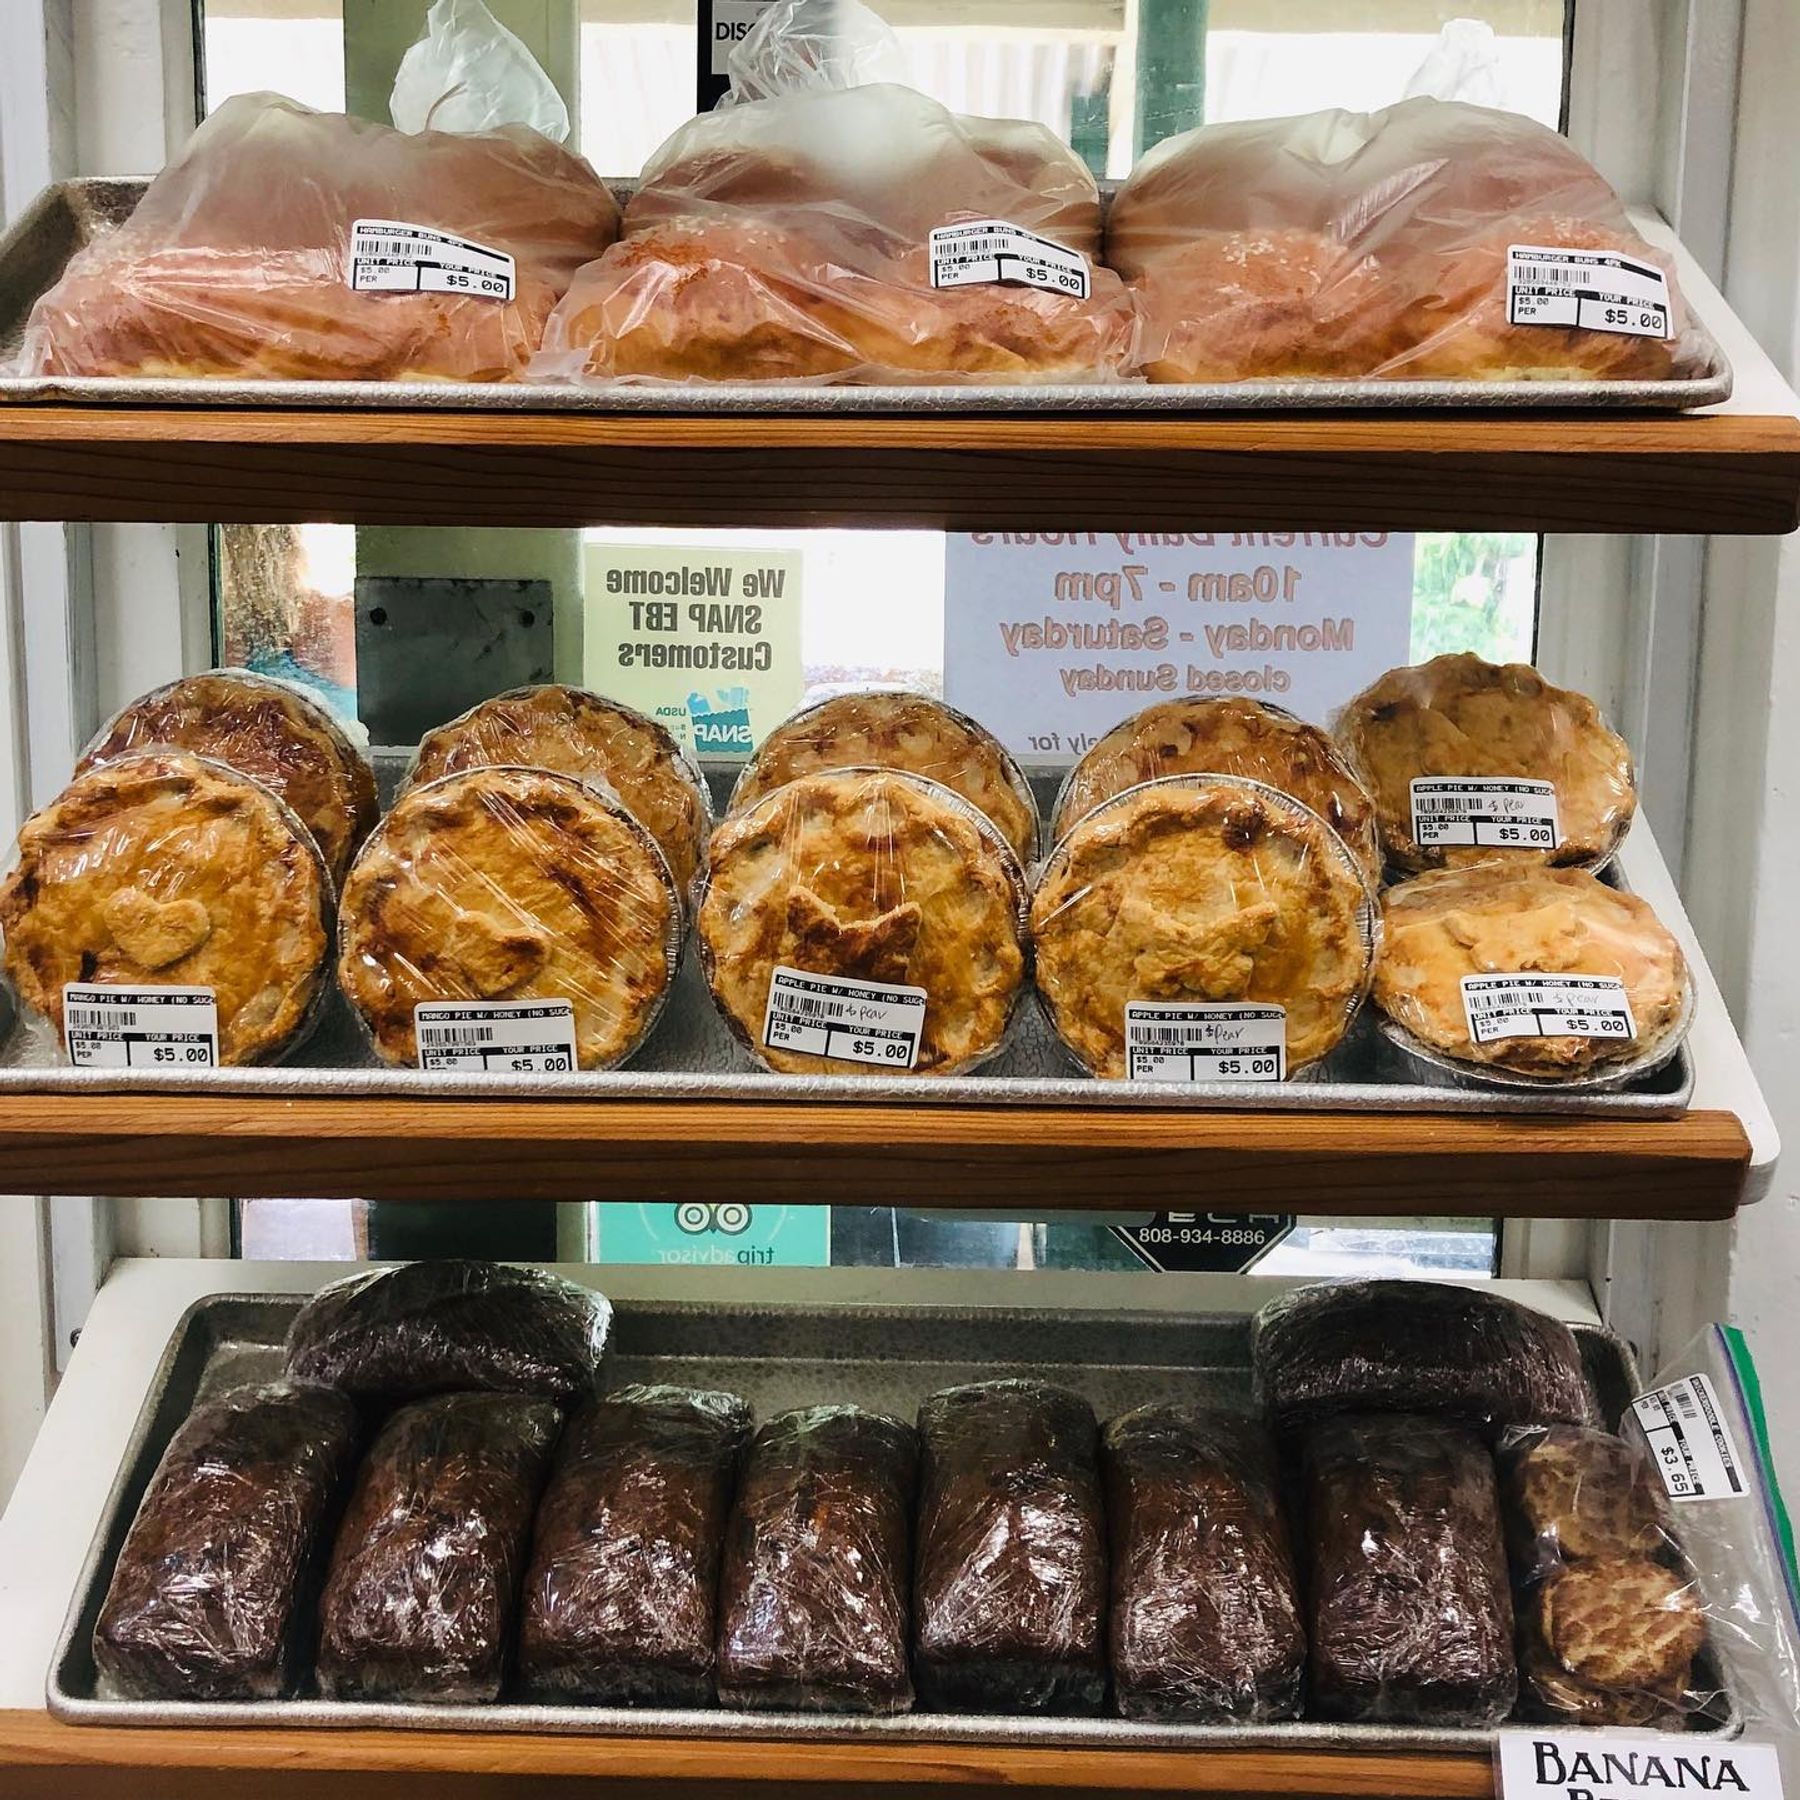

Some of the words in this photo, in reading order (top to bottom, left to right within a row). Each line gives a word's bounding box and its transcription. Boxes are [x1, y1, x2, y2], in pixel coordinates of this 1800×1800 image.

[1515, 252, 1569, 263] HAMBURGER
[360, 275, 377, 283] PER
[446, 275, 504, 293] $5.00
[1026, 268, 1079, 289] $5.00
[1545, 288, 1575, 297] PRICE
[1599, 292, 1622, 303] YOUR
[1627, 296, 1655, 309] PRICE
[1518, 307, 1536, 315] PER
[1605, 309, 1662, 329] $5.00
[1500, 828, 1550, 841] $5.00
[778, 976, 805, 989] APPLE
[810, 982, 827, 993] PIE
[848, 989, 877, 999] HONEY
[1467, 981, 1498, 990] APPLE
[69, 994, 96, 1002] MANGO
[100, 995, 116, 1003] PIE
[421, 1012, 450, 1020] MANGO
[772, 1013, 794, 1021] UNIT
[800, 1018, 827, 1029] PRICE
[1131, 1011, 1160, 1019] APPLE
[1165, 1012, 1183, 1020] PIE
[1204, 1012, 1233, 1020] HONEY
[1481, 1027, 1499, 1035] PER
[1567, 1019, 1624, 1032] $5.00
[773, 1031, 790, 1041] PER
[849, 1026, 871, 1034] YOUR
[875, 1030, 903, 1039] PRICE
[154, 1048, 208, 1061] $5.00
[530, 1045, 558, 1053] PRICE
[853, 1040, 907, 1059] $5.00
[511, 1058, 566, 1071] $5.00
[1136, 1065, 1154, 1073] PER
[1218, 1060, 1274, 1074] $5.00
[1139, 1228, 1265, 1245] 808-934-8886
[1661, 1446, 1689, 1492] $3.65
[1532, 1741, 1750, 1792] BANANA
